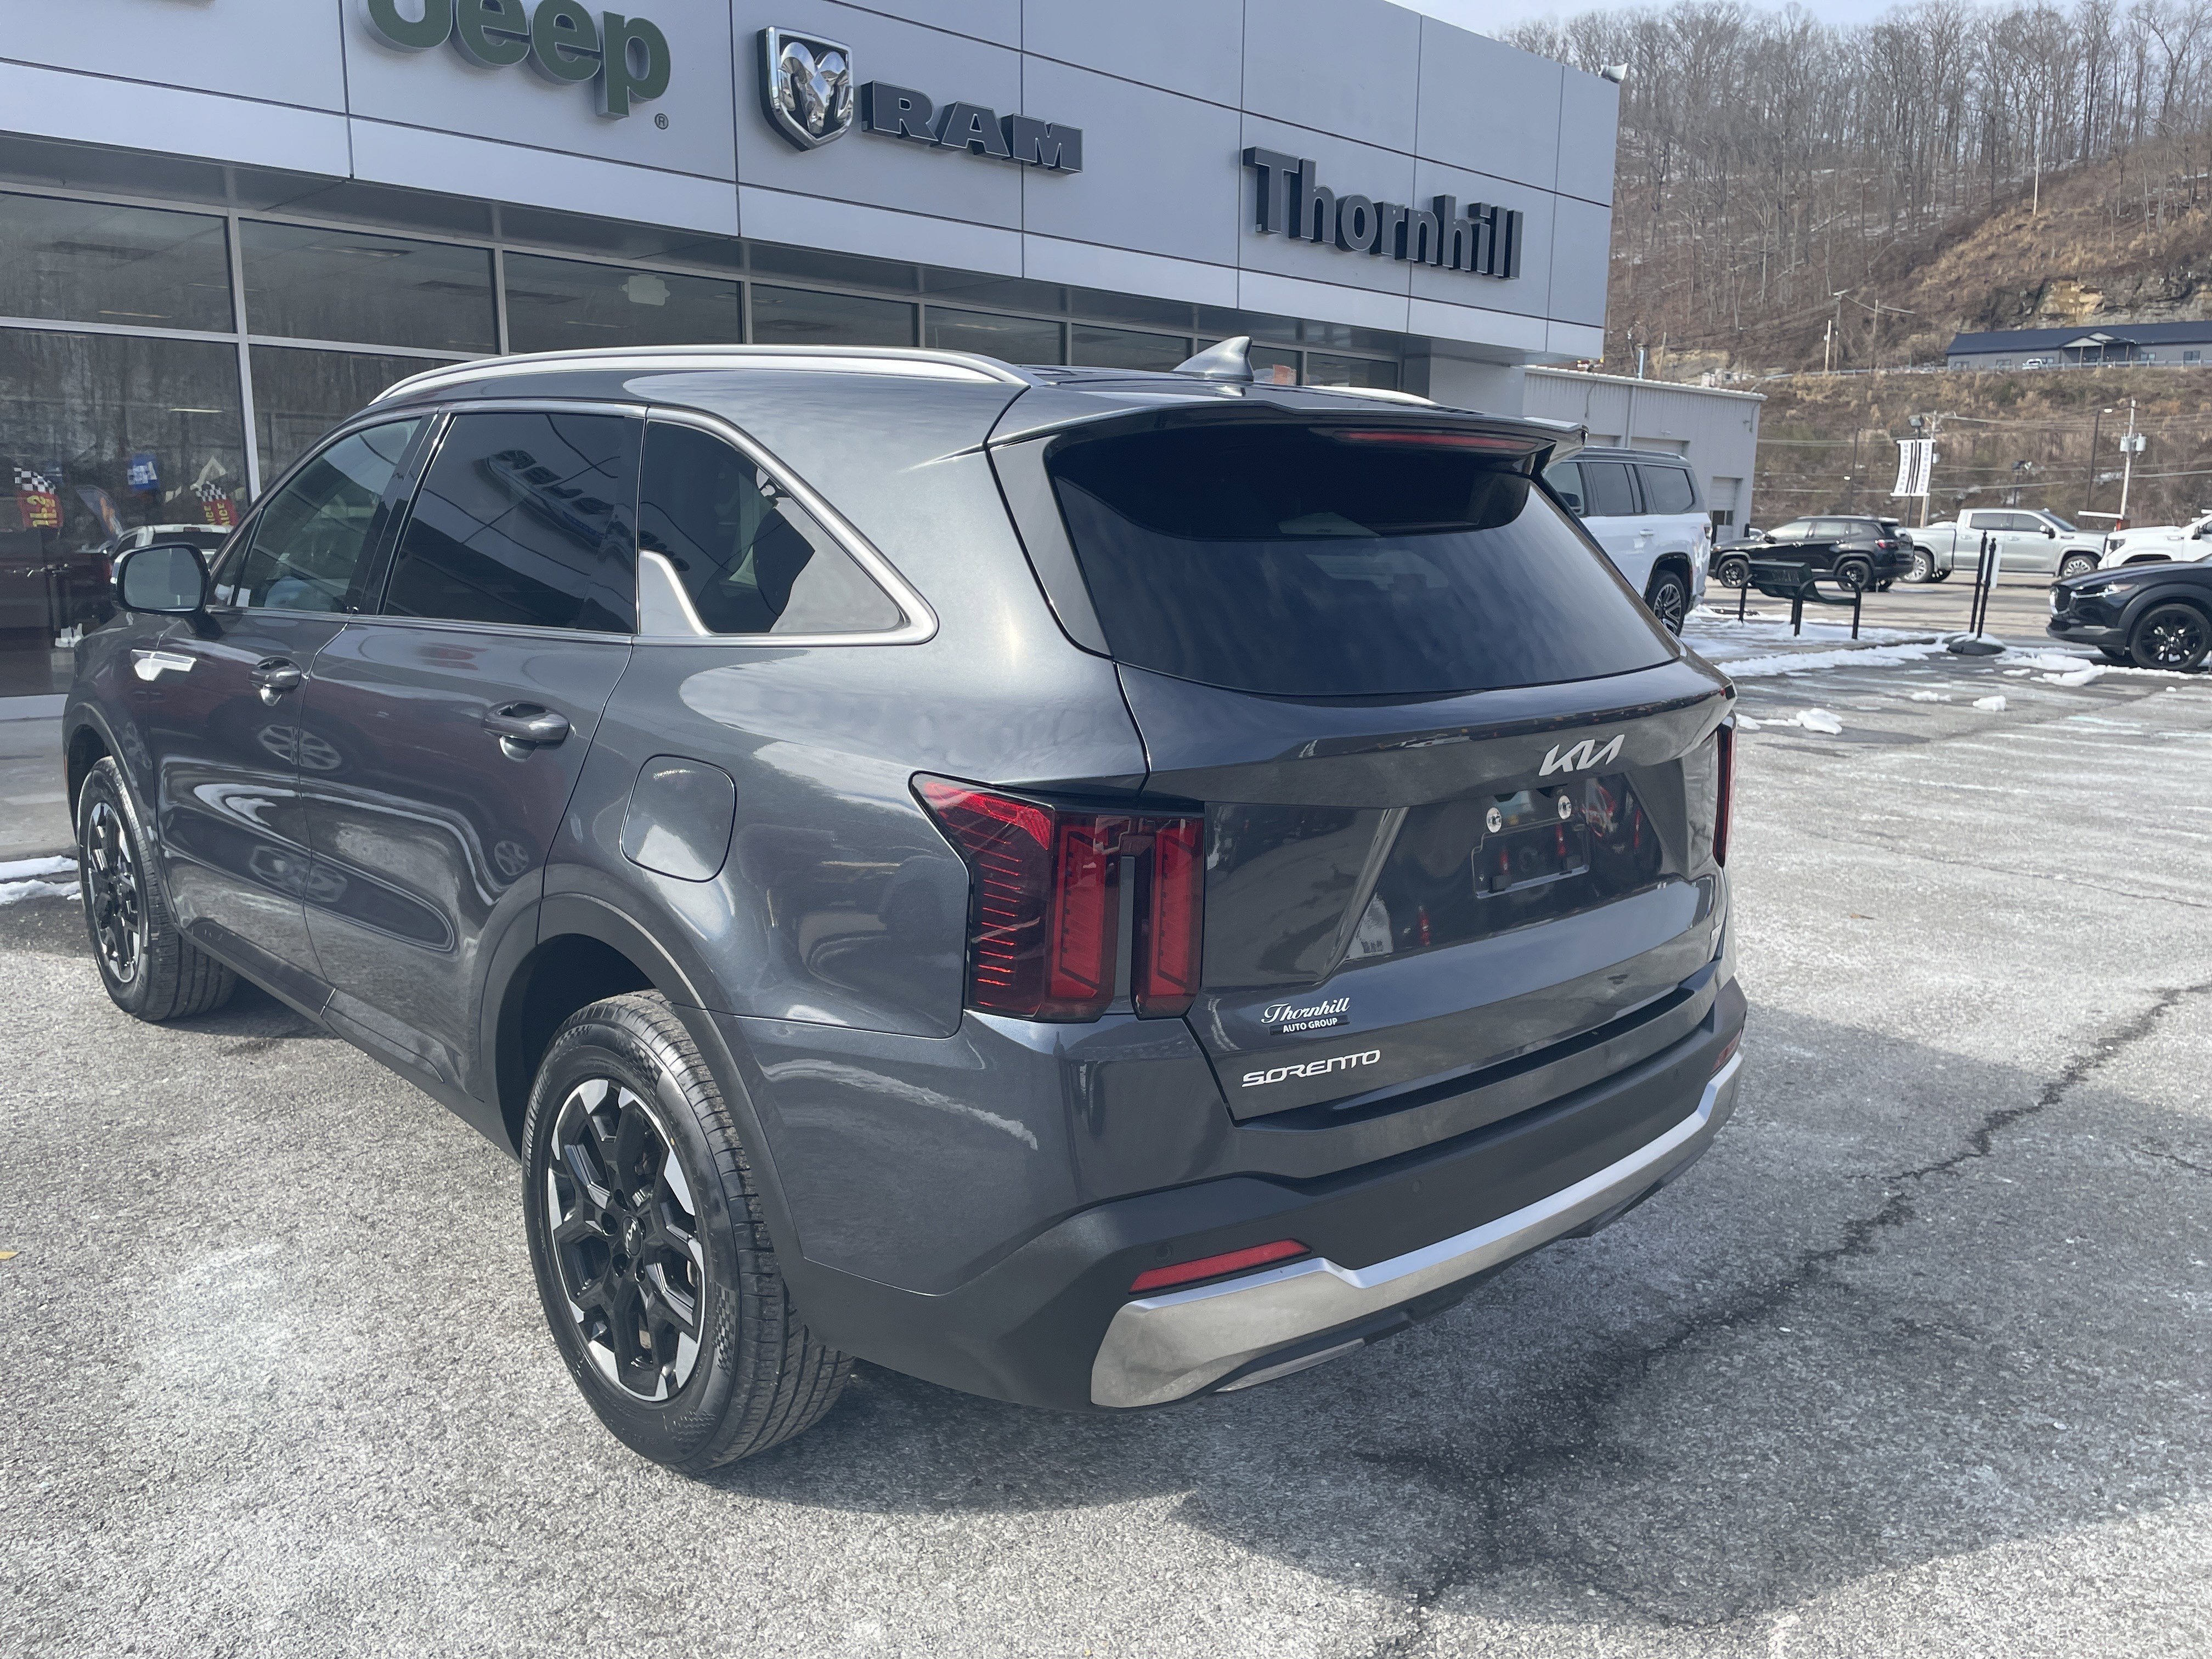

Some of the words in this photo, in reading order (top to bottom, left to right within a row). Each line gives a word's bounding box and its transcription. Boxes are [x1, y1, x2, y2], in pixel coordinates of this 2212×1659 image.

[862, 81, 1083, 174] RAM
[1243, 146, 1524, 279] Thornhill
[1538, 734, 1625, 776] KIA
[1261, 997, 1351, 1024] Thornhill
[1282, 1022, 1307, 1034] AUTO
[1308, 1017, 1339, 1029] GROUP
[1242, 1049, 1381, 1087] SORENTO
